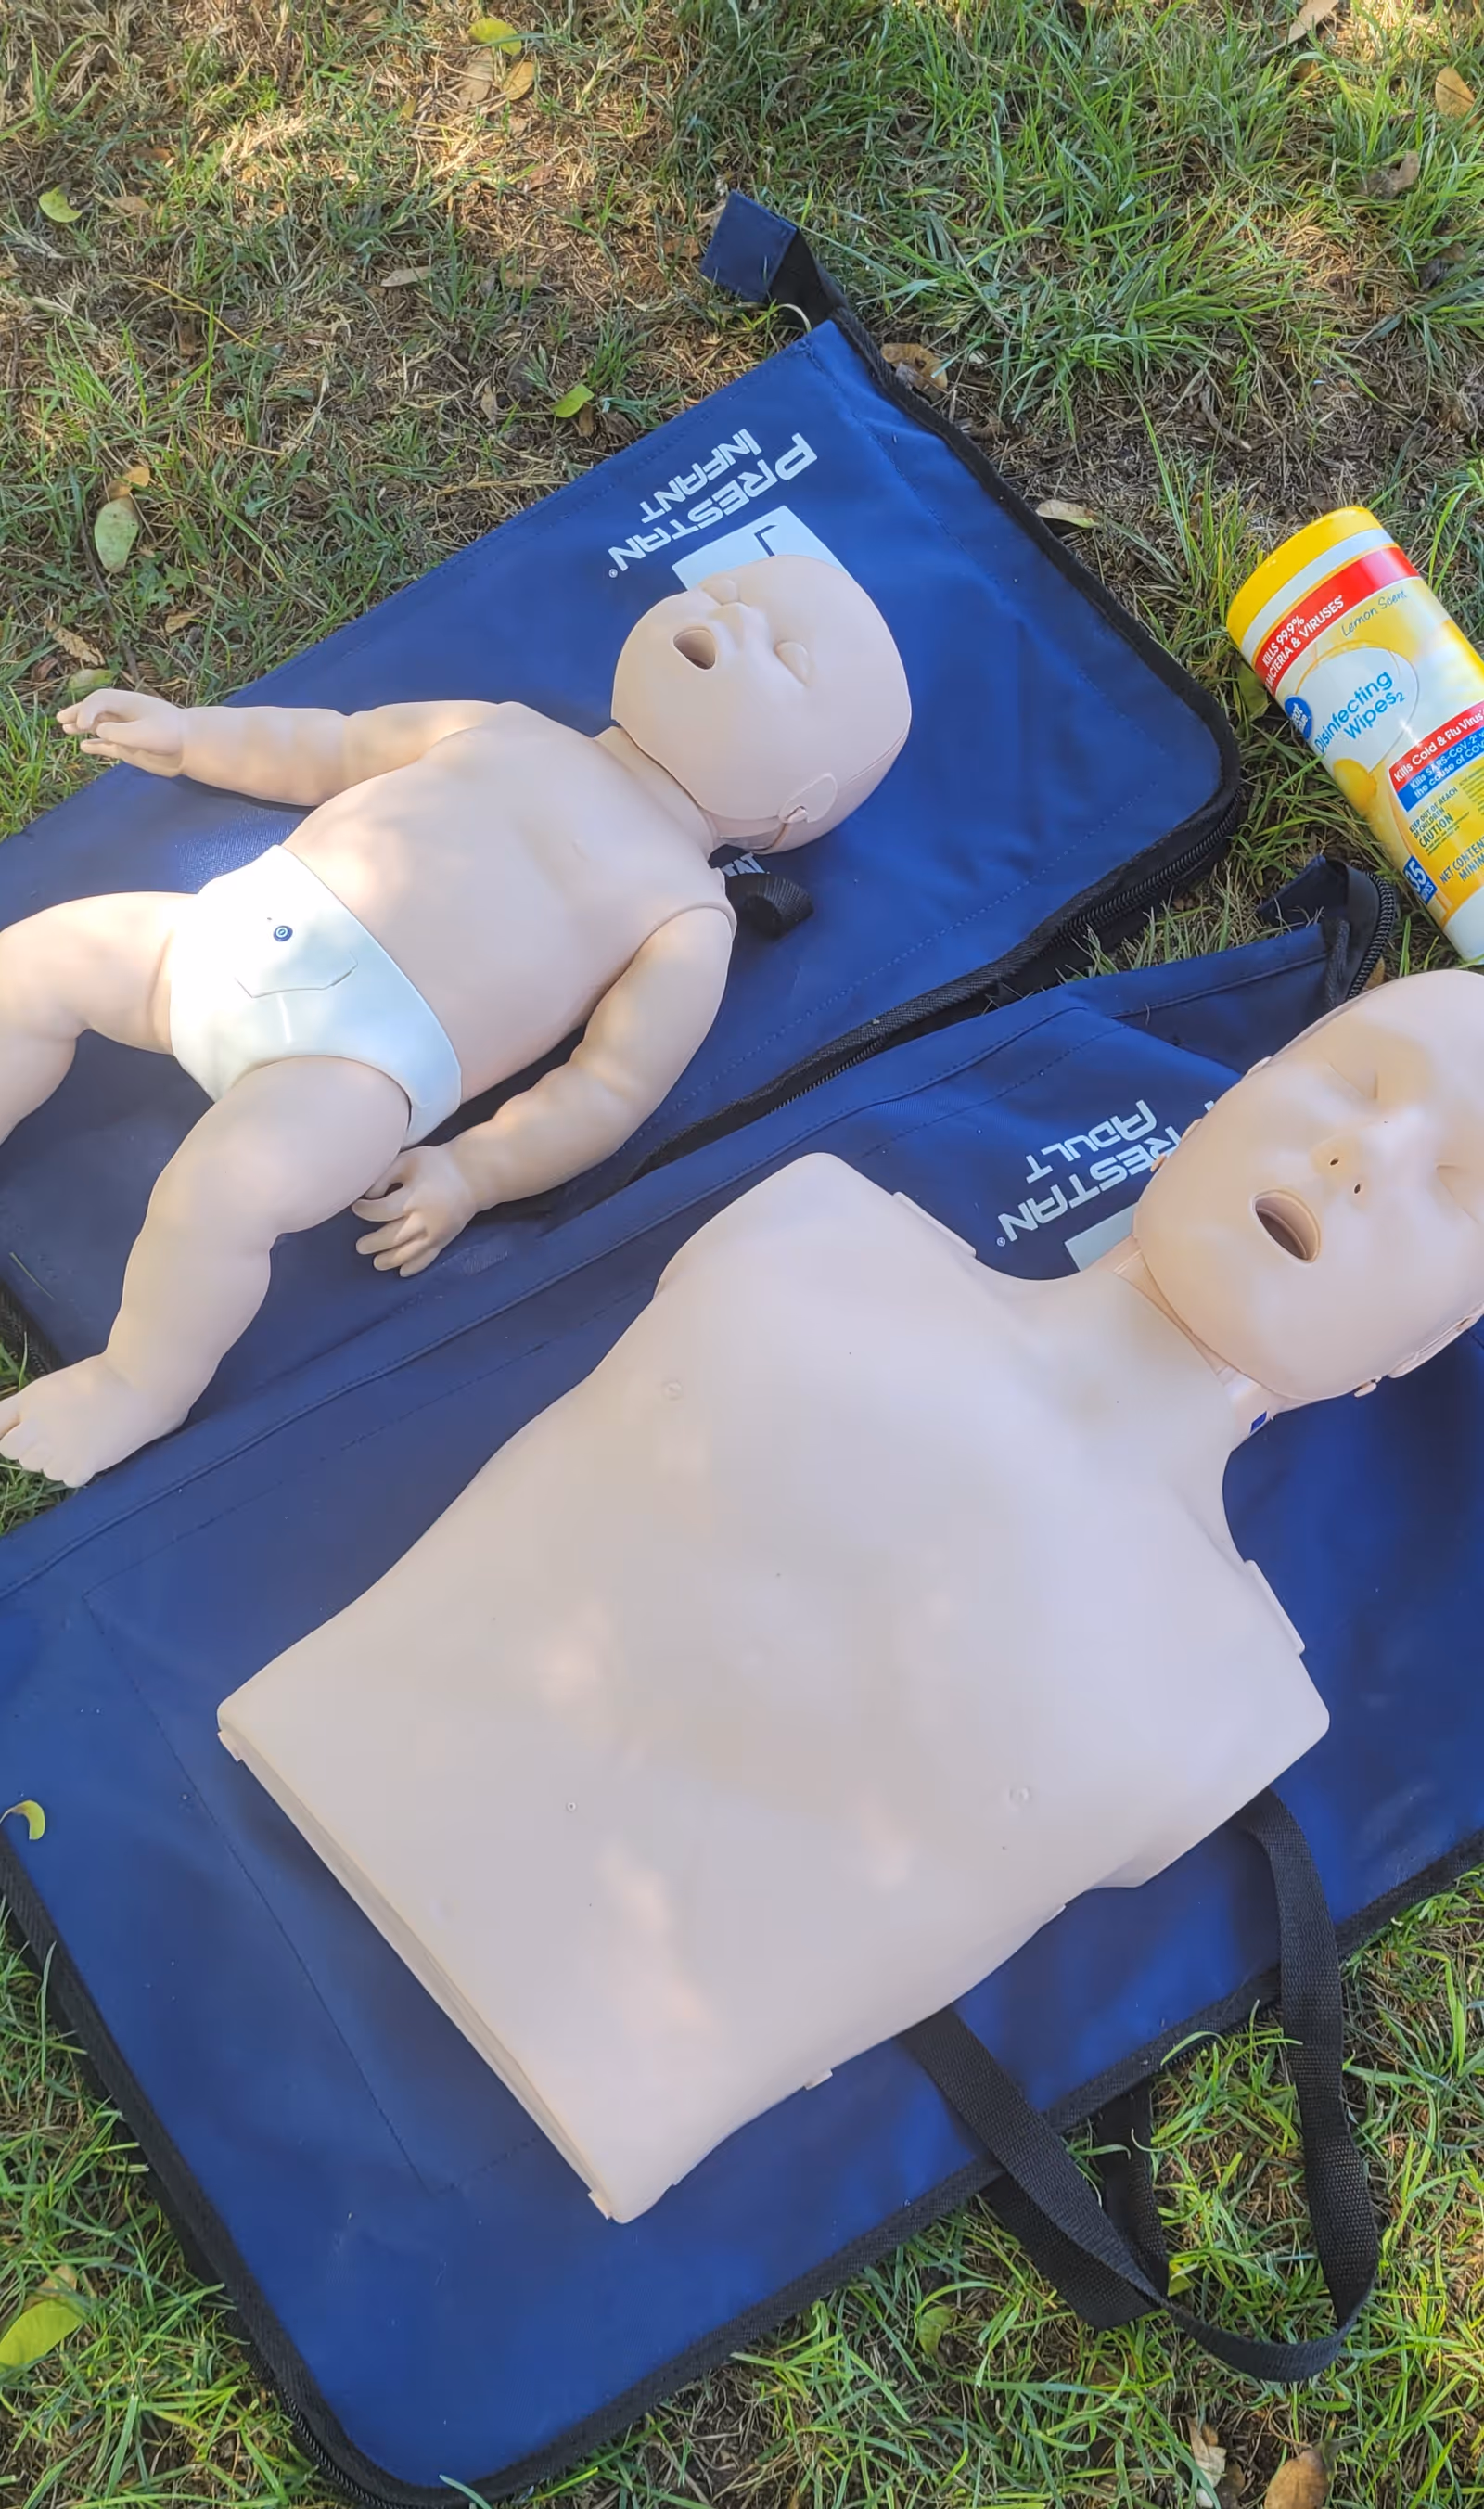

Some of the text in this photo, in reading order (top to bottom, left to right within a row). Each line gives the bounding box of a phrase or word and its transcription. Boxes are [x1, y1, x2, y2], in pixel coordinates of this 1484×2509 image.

[640, 429, 762, 523] INFANT
[1341, 589, 1407, 636] Lemon Scent
[1261, 615, 1304, 667] KILLS 99.9%
[1290, 637, 1301, 648] &
[1314, 672, 1392, 754] Disinfecting
[1393, 763, 1414, 782] Kills
[1412, 742, 1438, 765] Cold
[1437, 736, 1447, 746] &
[1444, 726, 1462, 740] Flu
[1414, 784, 1428, 799] the
[1429, 762, 1454, 786] cause
[1455, 754, 1465, 765] of
[1410, 774, 1426, 789] Kills
[1409, 787, 1458, 833] KEEP OUT OF REACH
[1419, 806, 1445, 832] CHILDREN
[1419, 813, 1453, 847] CAUTION
[1439, 865, 1454, 884] NET
[1026, 1100, 1158, 1184] ADULT
